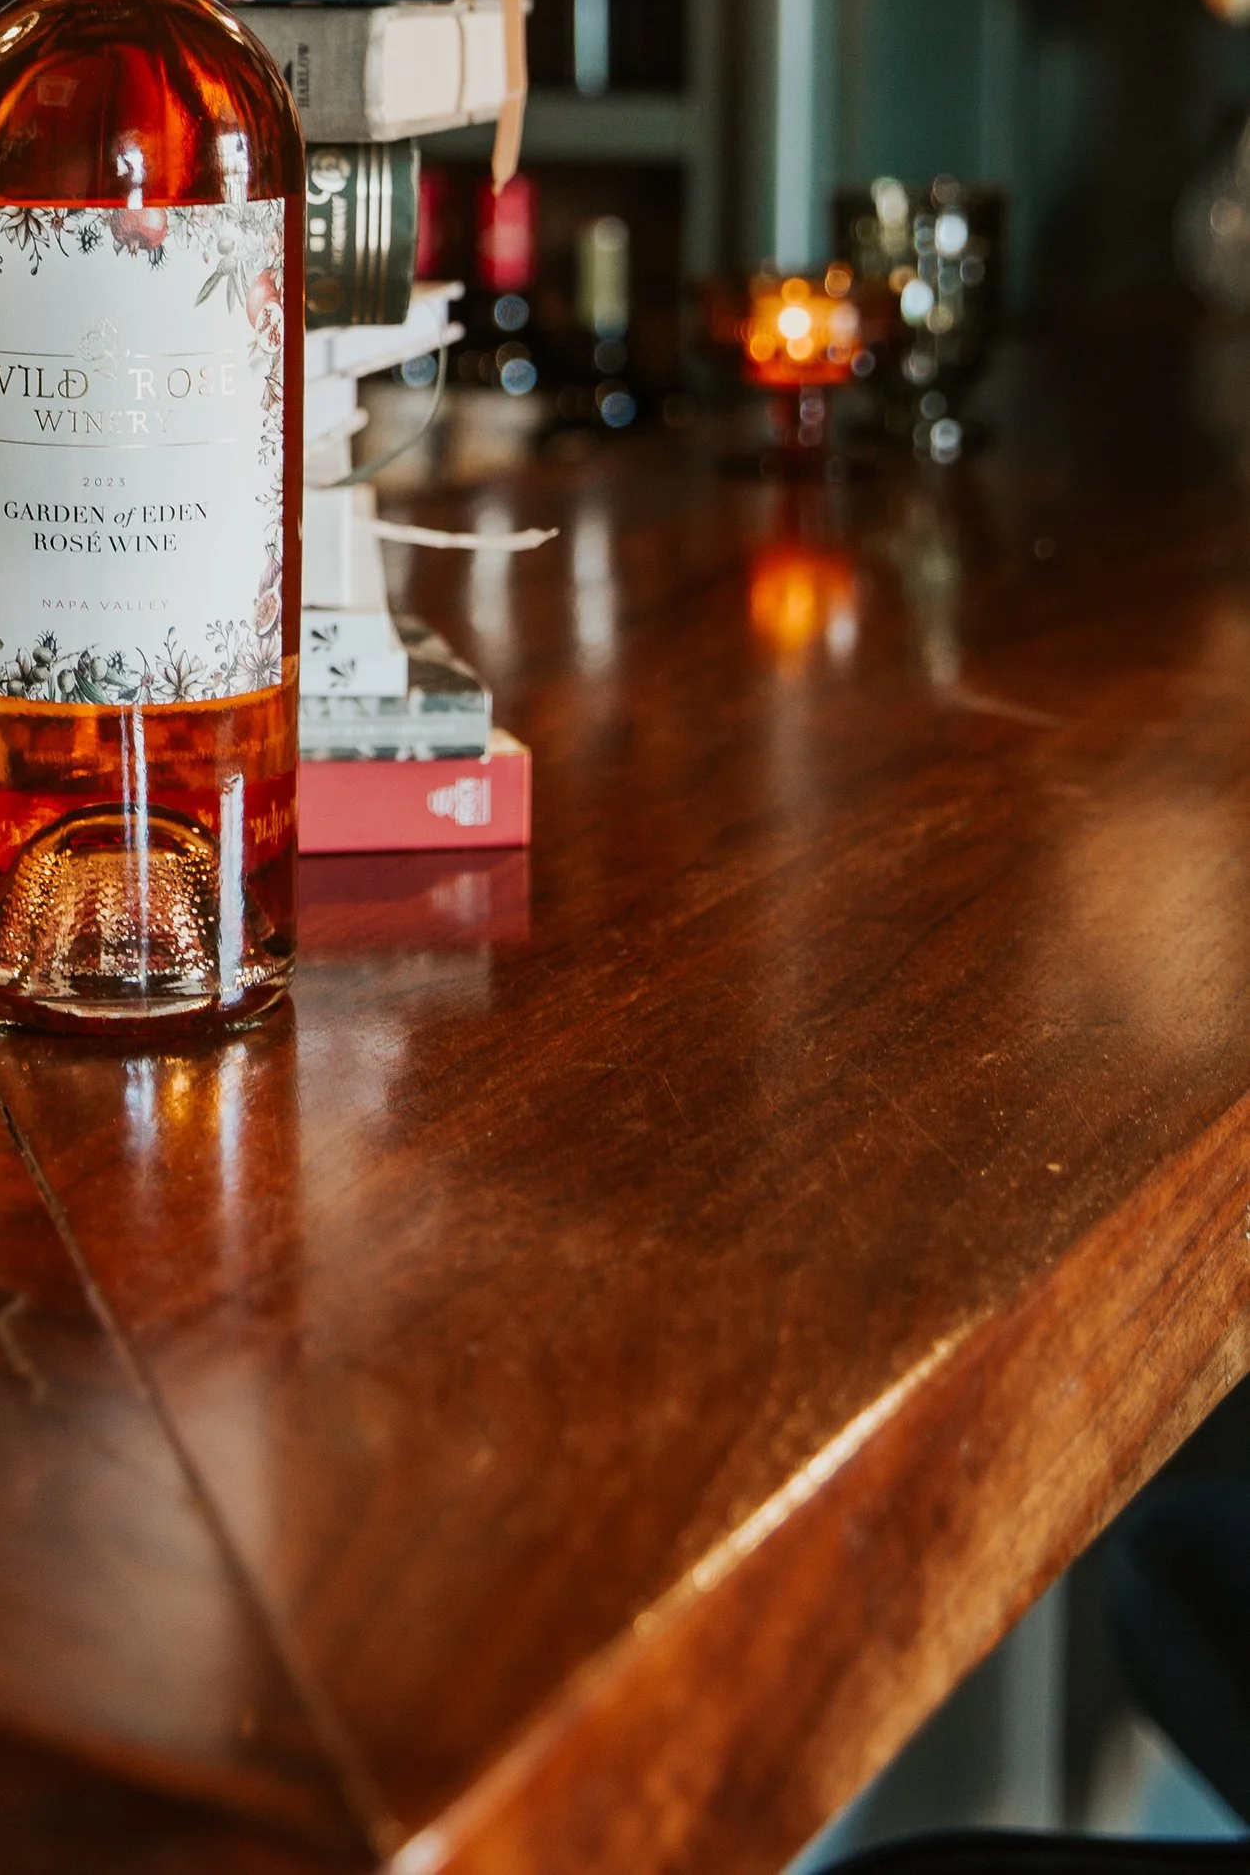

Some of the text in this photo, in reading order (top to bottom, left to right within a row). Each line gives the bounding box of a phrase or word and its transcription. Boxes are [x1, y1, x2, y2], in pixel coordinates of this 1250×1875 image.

[128, 363, 236, 401] ROSE
[33, 409, 174, 435] WINERY
[82, 477, 126, 487] 2023
[3, 500, 209, 528] GARDEN of EDEN
[33, 531, 177, 553] ROSÉ WINE
[42, 598, 169, 611] NAPA VALLEY
